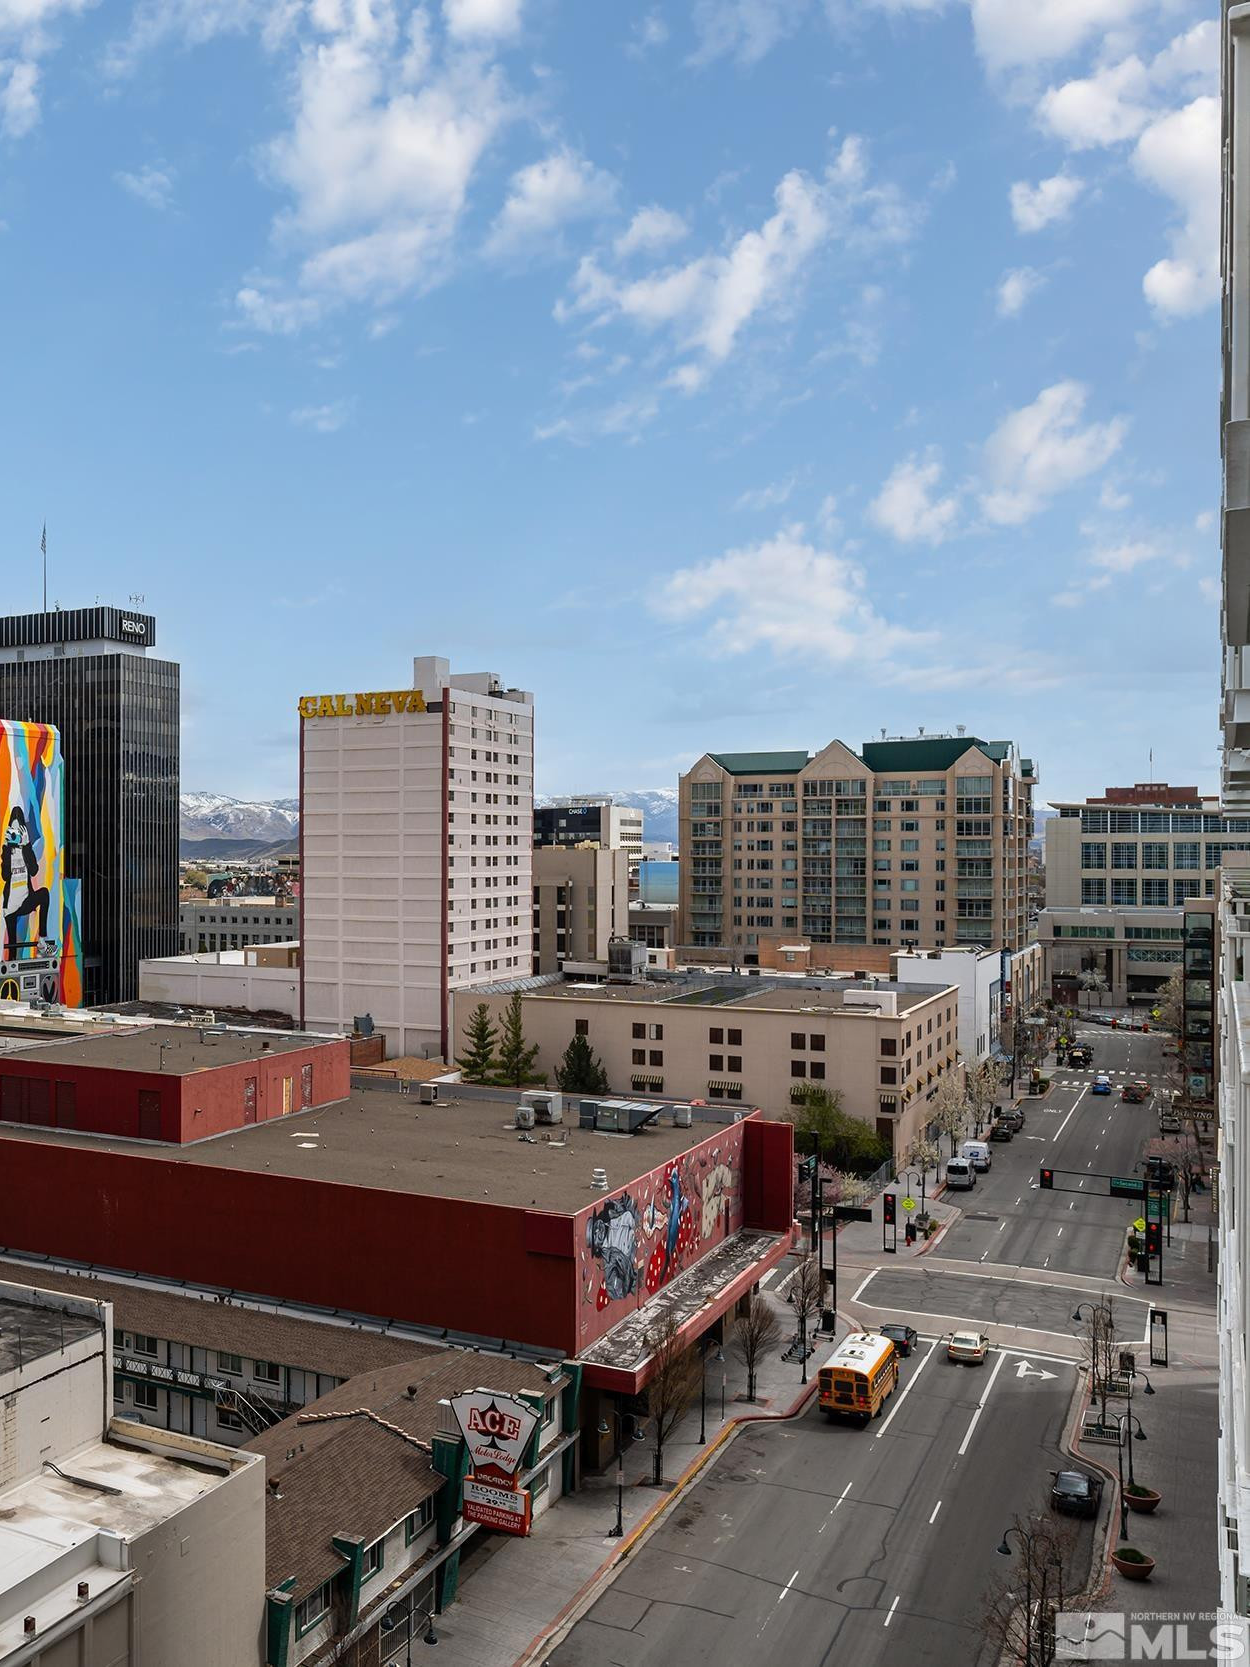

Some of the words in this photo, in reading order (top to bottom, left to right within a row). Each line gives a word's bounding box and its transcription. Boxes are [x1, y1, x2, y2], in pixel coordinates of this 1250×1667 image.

[122, 619, 146, 634] RENO
[299, 694, 353, 719] CAL
[355, 689, 427, 716] NEVA
[468, 1407, 522, 1441] ACE
[493, 1449, 517, 1466] Lodge
[470, 1484, 518, 1501] ROOMS
[467, 1503, 493, 1516] VALIDATED
[493, 1509, 514, 1521] PARKING
[467, 1510, 477, 1518] THE
[476, 1513, 498, 1524] PARKING
[498, 1518, 521, 1529] GALLERY
